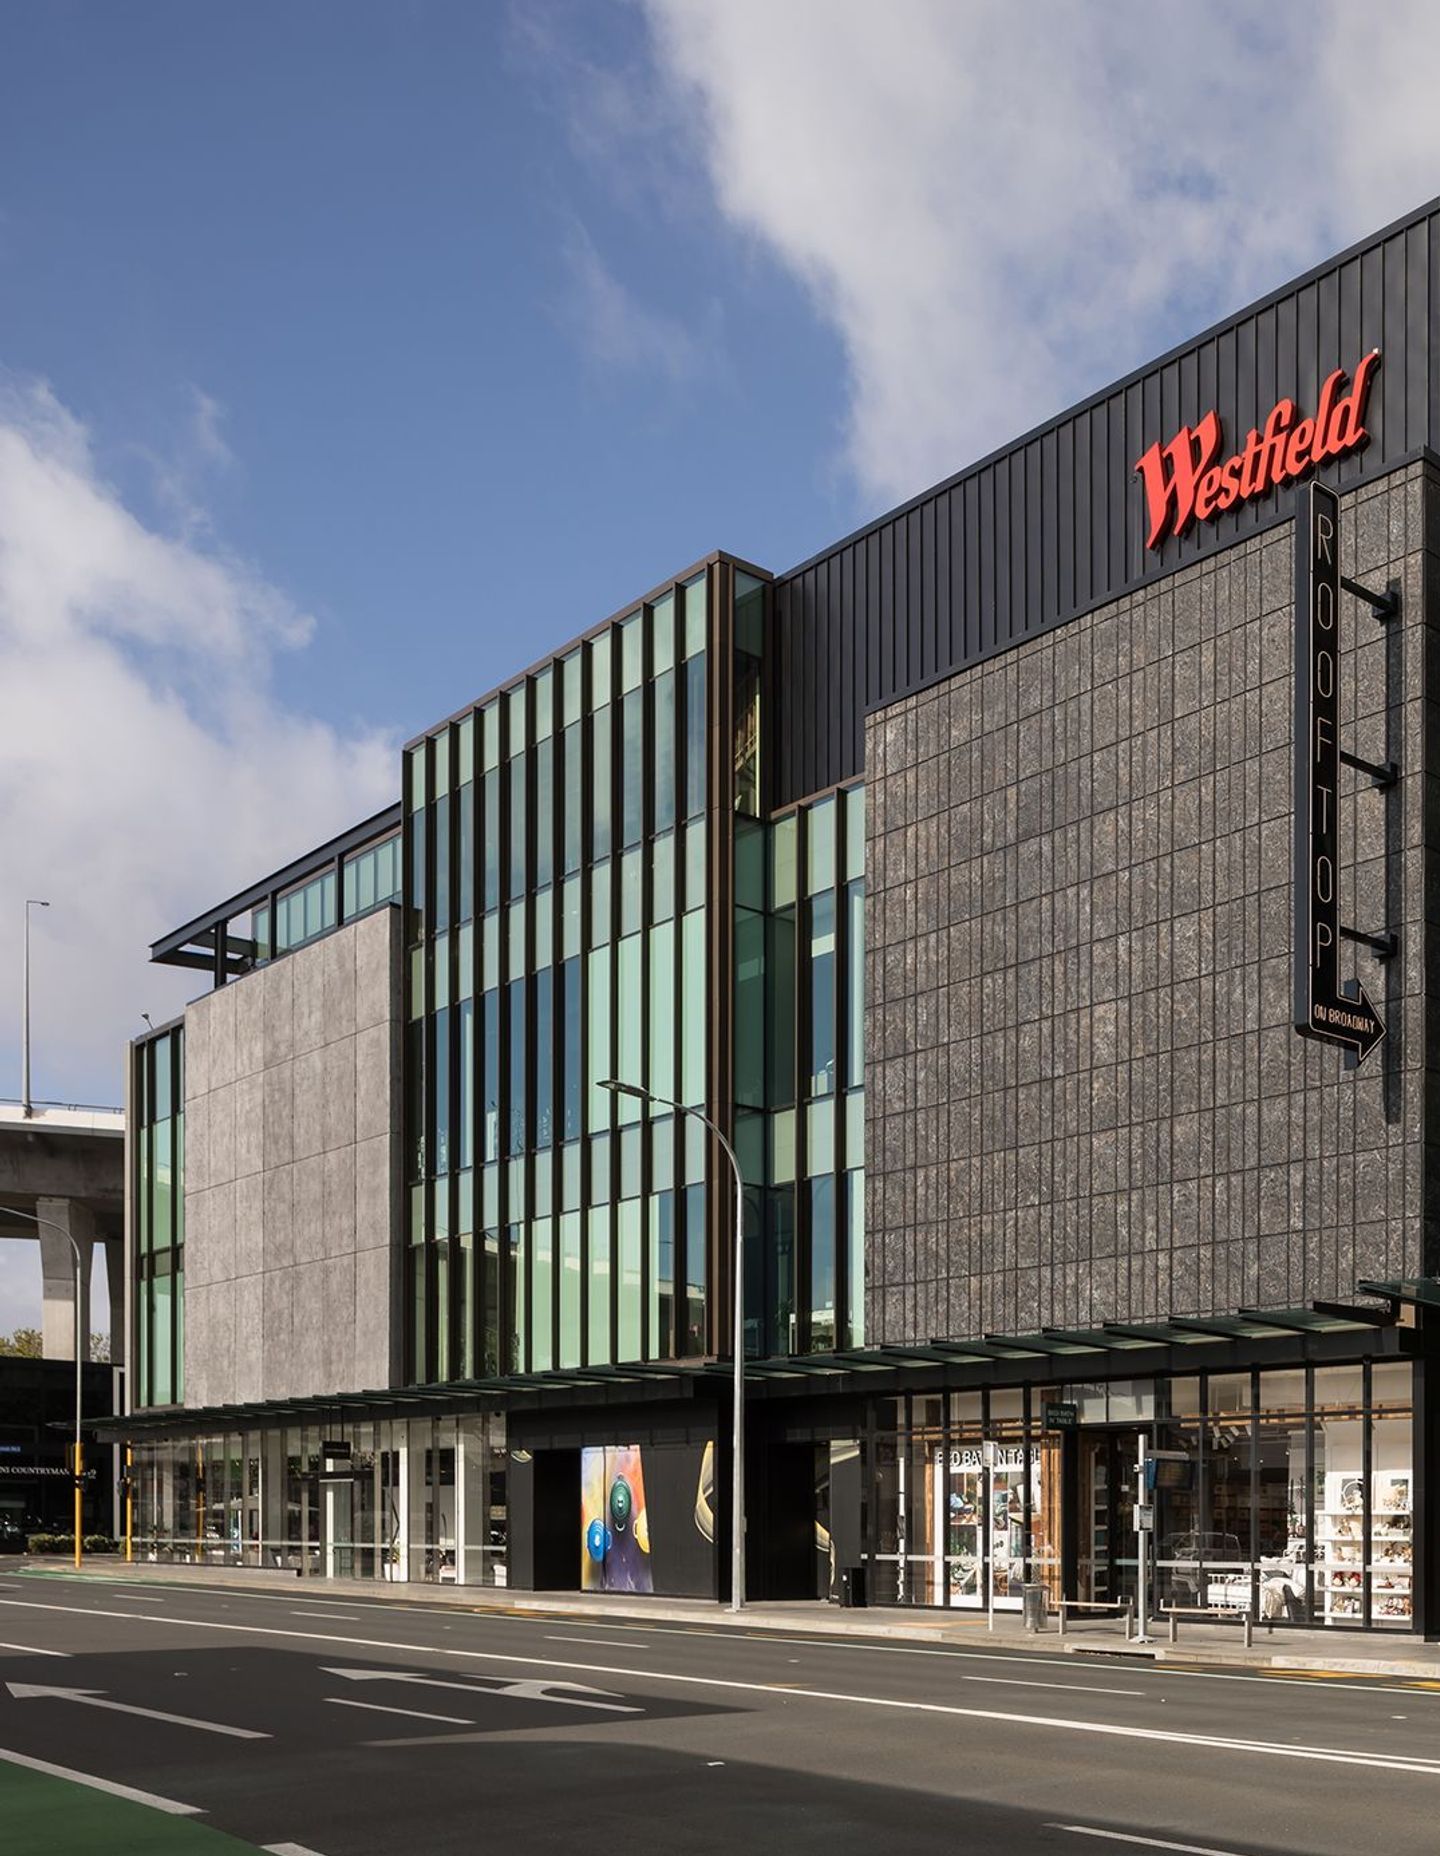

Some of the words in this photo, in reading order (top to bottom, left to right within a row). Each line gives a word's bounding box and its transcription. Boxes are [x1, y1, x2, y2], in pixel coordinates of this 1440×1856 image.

[1135, 348, 1380, 550] Westfield
[1316, 513, 1334, 969] ROOFTOP
[1313, 1003, 1327, 1021] ON
[1328, 1008, 1375, 1034] BROADWAY
